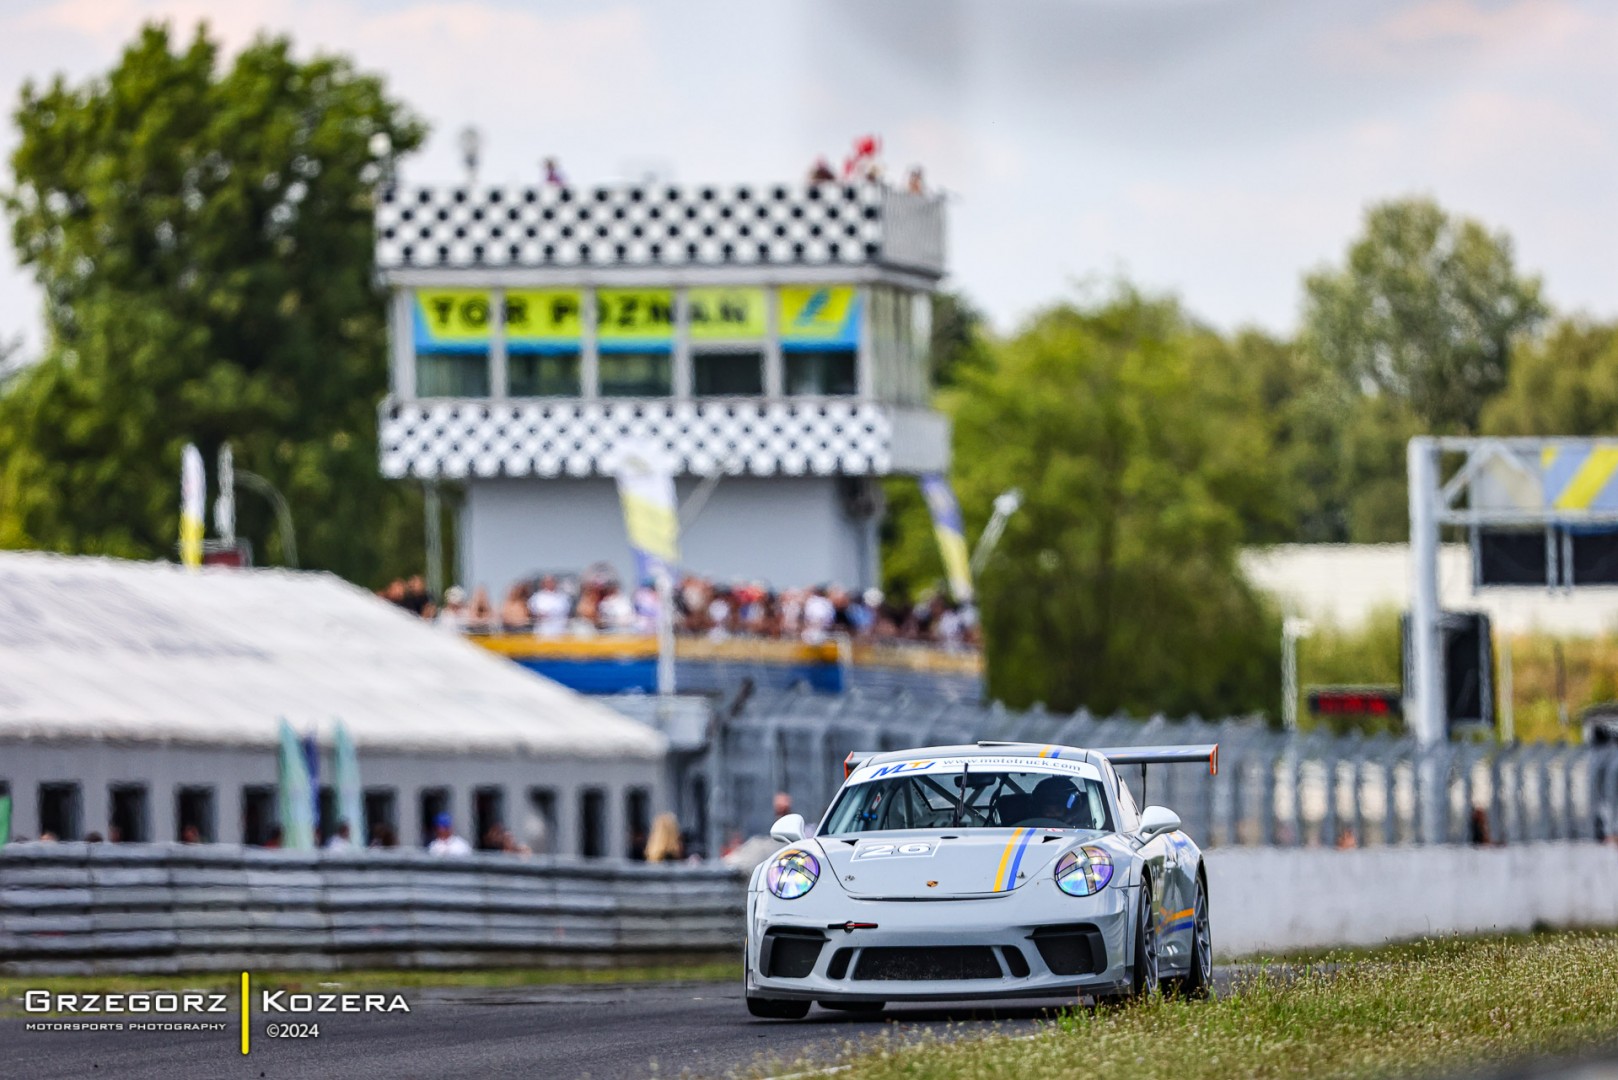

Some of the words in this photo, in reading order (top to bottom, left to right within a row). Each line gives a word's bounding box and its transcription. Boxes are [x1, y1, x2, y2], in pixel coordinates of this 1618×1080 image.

[432, 296, 529, 327] TOR
[943, 757, 1081, 771] www.mototruck.com
[859, 842, 932, 858] 26
